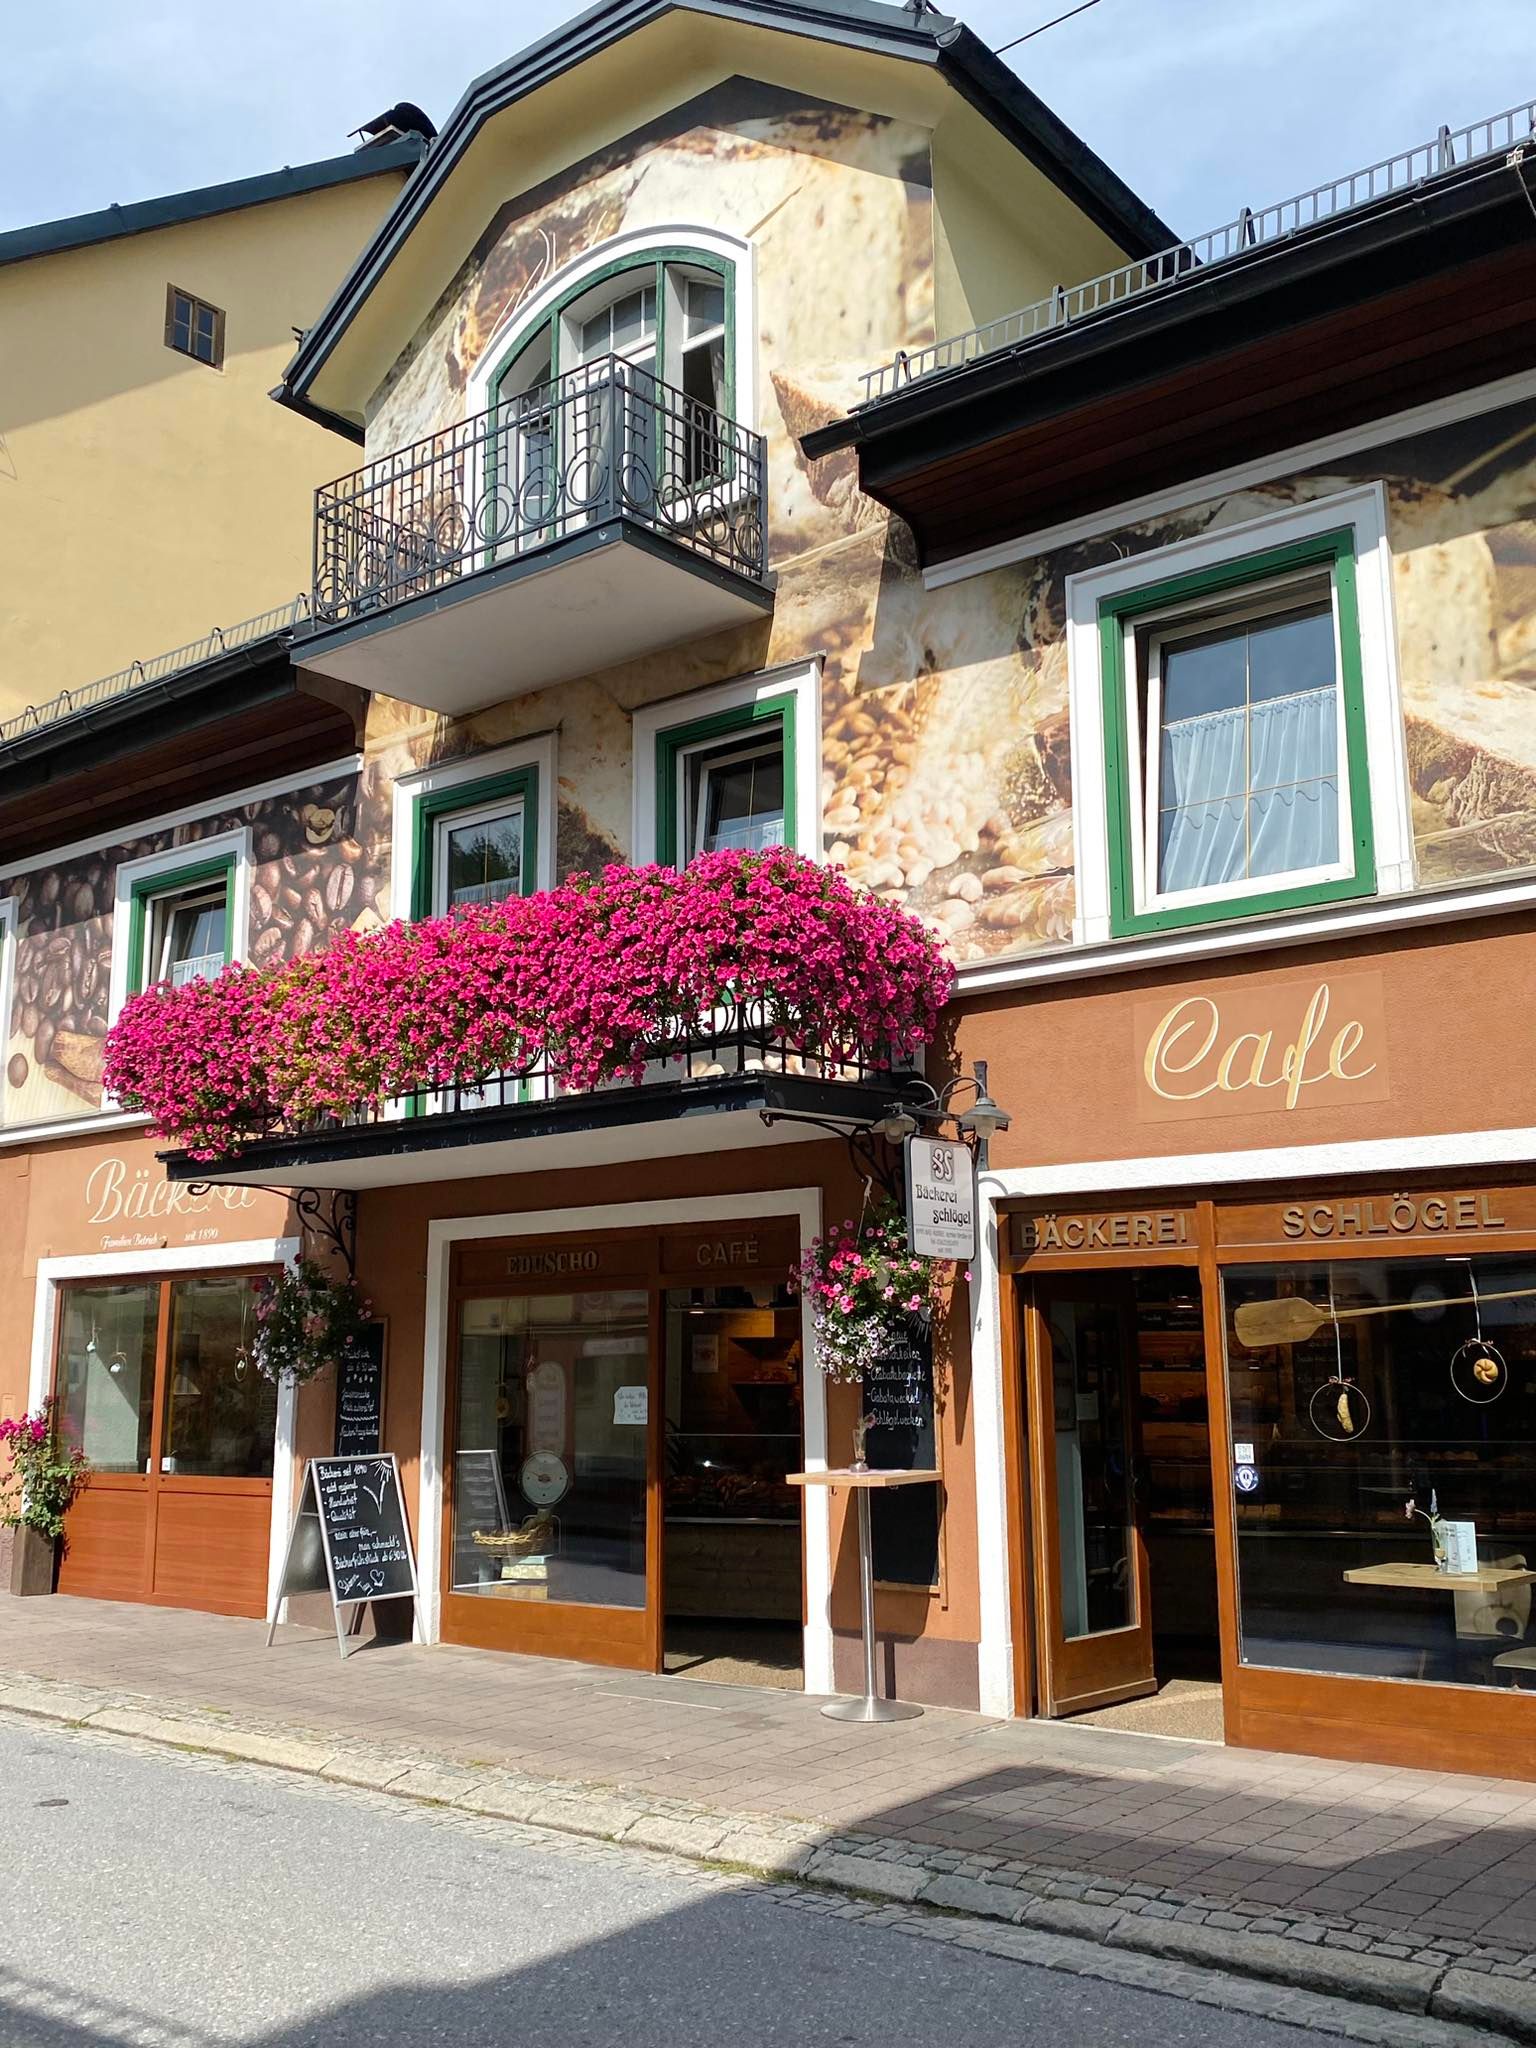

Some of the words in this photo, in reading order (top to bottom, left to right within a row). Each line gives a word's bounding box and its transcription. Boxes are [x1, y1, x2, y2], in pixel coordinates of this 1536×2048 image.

[1143, 983, 1376, 1110] Cafe
[915, 1183, 958, 1204] Bäckerei
[198, 1228, 219, 1241] 1890
[1021, 1213, 1188, 1249] BÄCKEREI
[1282, 1192, 1505, 1237] SCHLÖGEL
[507, 1250, 599, 1275] EDUSCHO
[696, 1234, 759, 1265] CAFÉ
